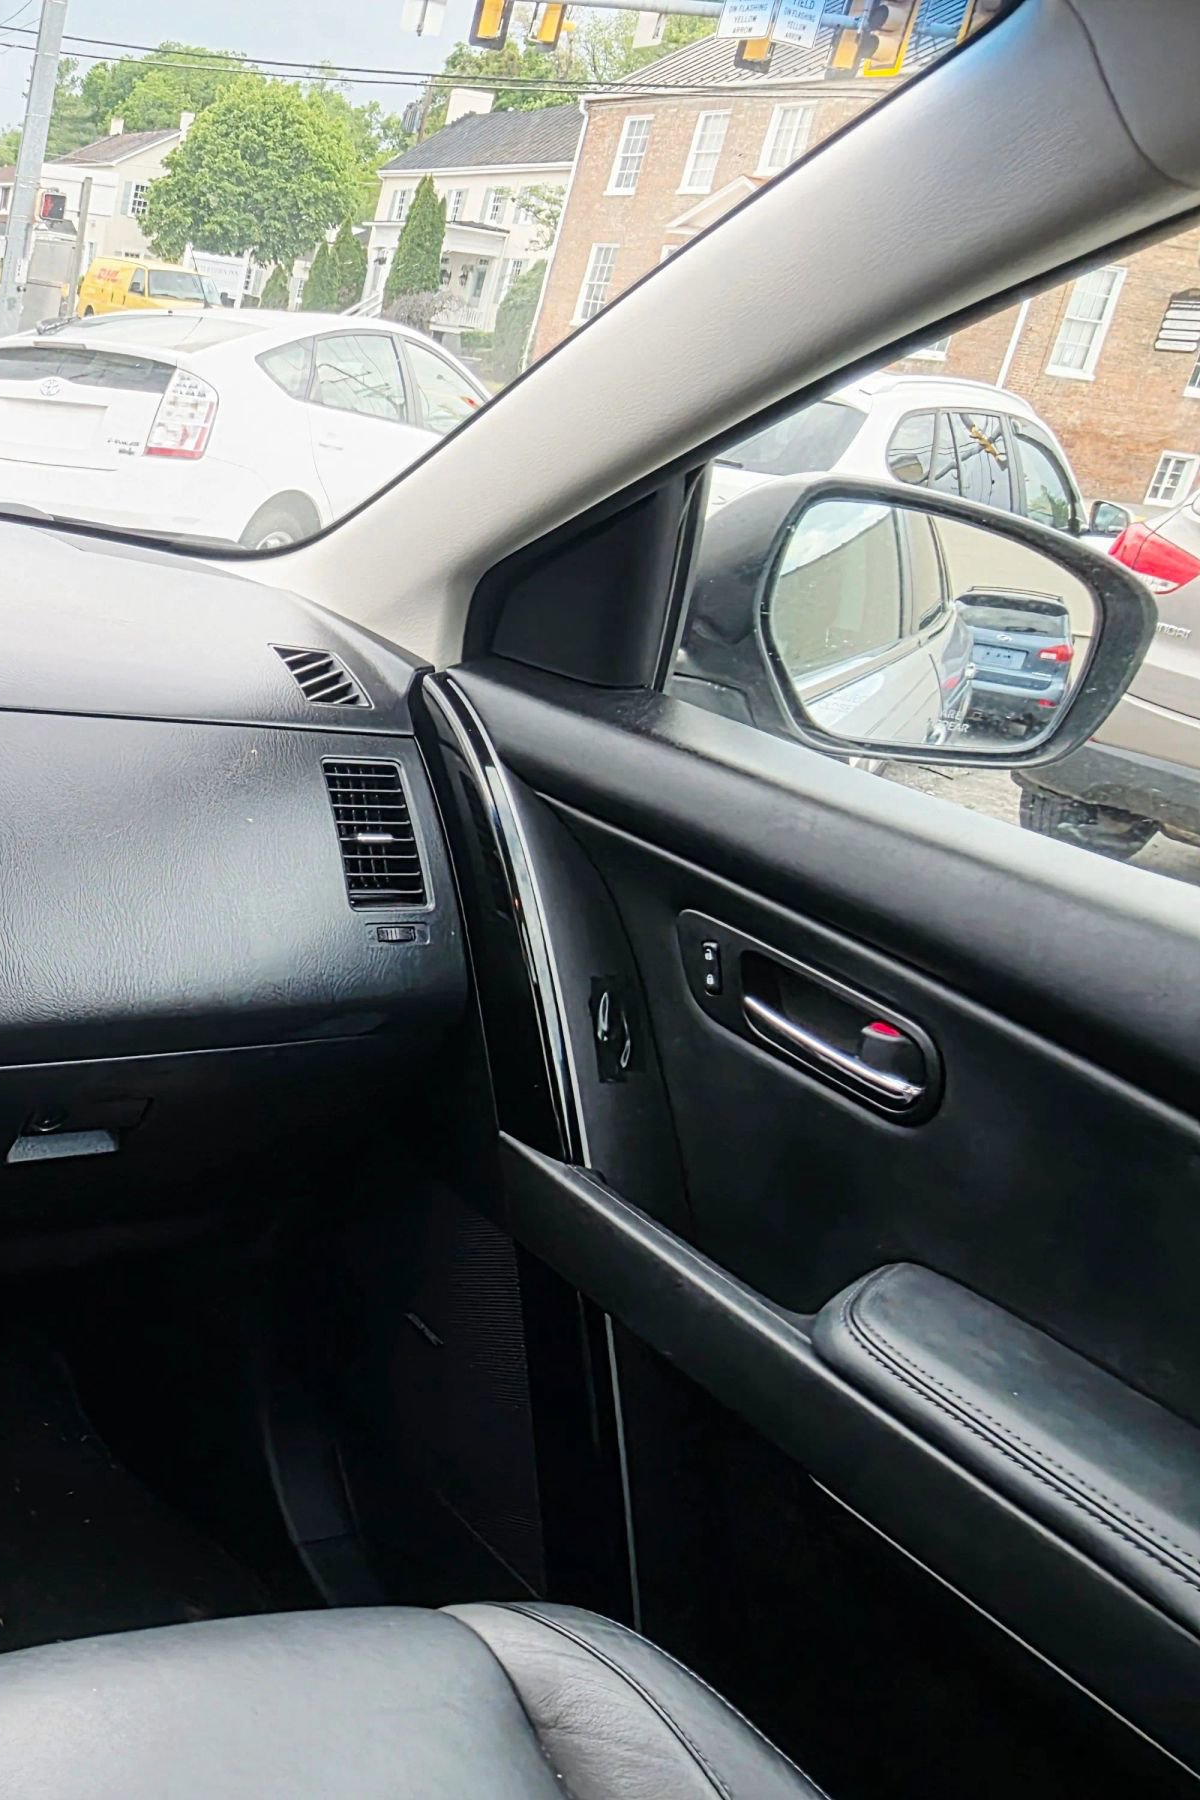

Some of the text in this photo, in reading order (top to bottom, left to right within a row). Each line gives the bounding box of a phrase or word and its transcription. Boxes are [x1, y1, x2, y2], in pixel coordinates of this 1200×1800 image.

[740, 4, 768, 12] FLASHING
[792, 10, 816, 22] FLASHING
[787, 21, 807, 31] YELLOW
[785, 32, 802, 41] ARROW
